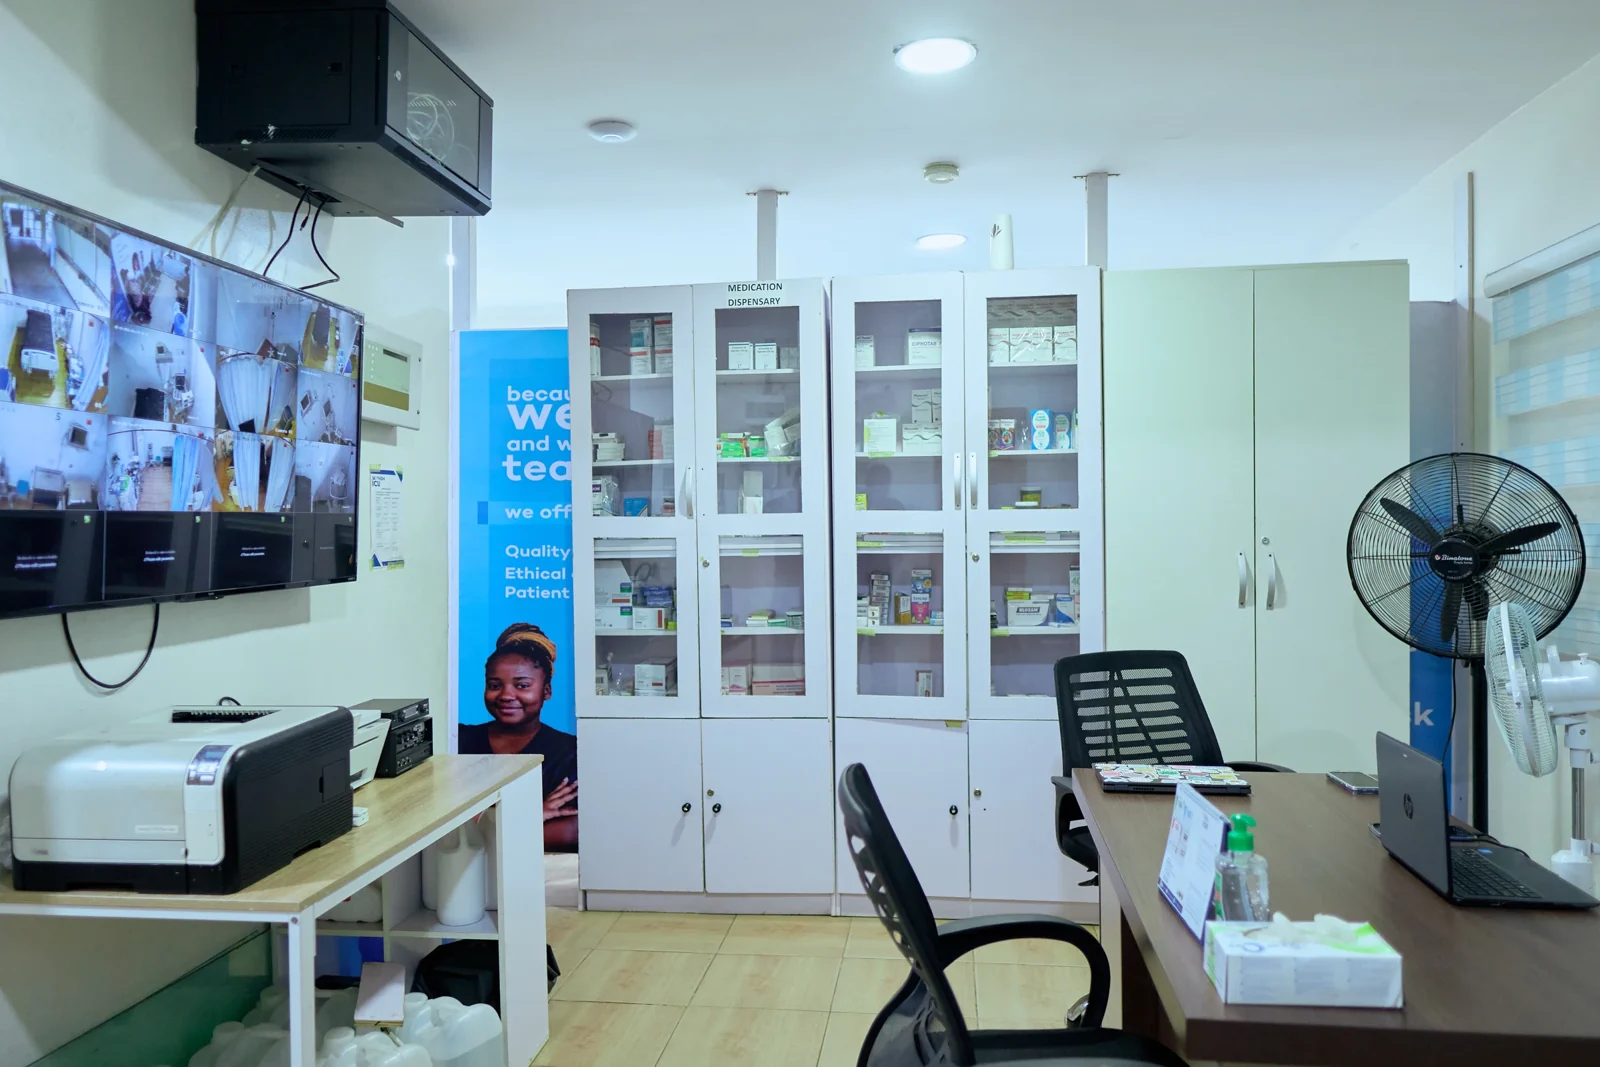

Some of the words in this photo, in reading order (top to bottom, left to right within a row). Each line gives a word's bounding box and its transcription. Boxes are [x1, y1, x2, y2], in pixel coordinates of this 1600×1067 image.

[727, 282, 783, 292] MEDICATION
[727, 297, 781, 307] DISPENSARY
[506, 403, 571, 430] we
[506, 435, 550, 452] and
[502, 454, 572, 481] tea
[504, 508, 534, 519] we
[539, 503, 572, 519] off
[505, 544, 571, 561] Quality
[505, 566, 566, 580] Ethical
[505, 585, 570, 599] Patient
